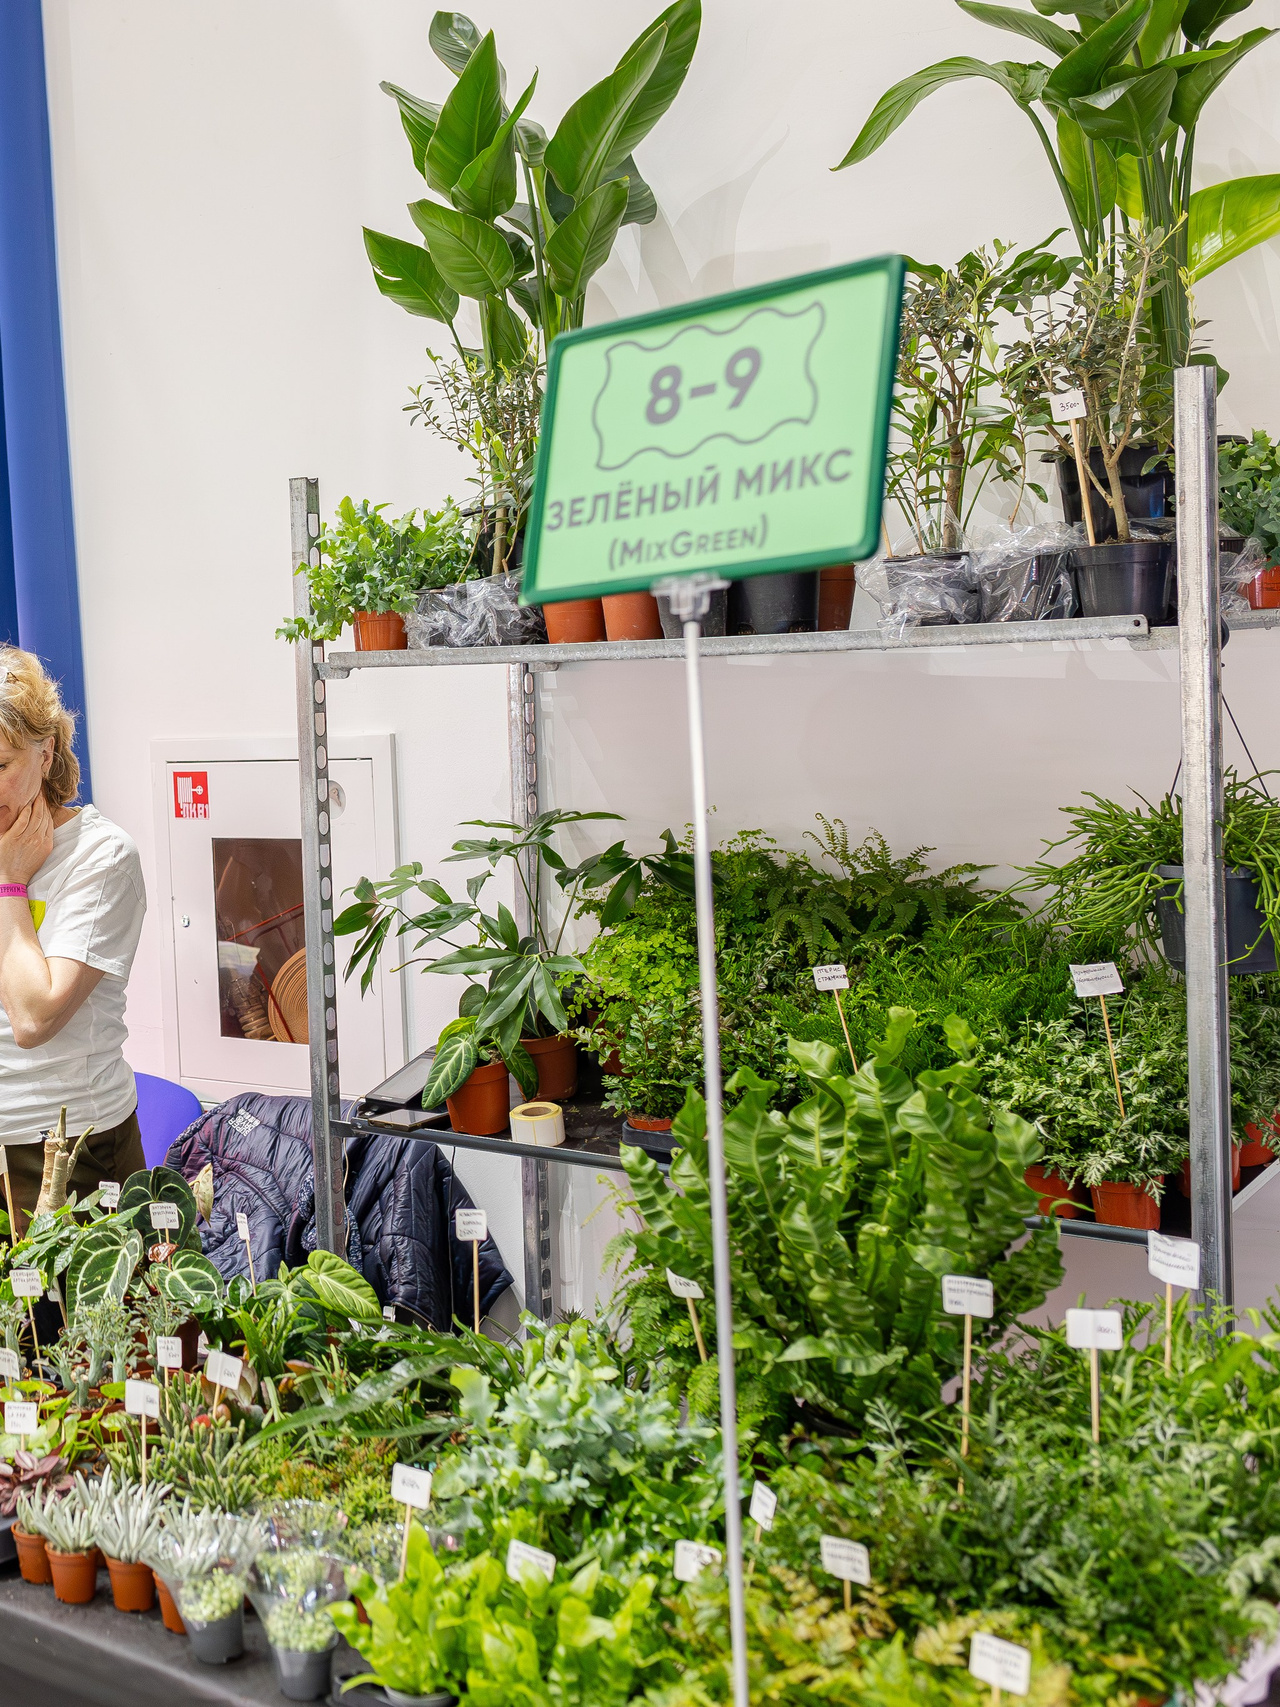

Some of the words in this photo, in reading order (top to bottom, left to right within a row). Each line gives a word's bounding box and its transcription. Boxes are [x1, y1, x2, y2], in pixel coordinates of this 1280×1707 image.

[545, 465, 720, 532] ЗЕЛЁНЫЙ
[734, 448, 854, 501] МИКС
[227, 1117, 249, 1137] SUPER
